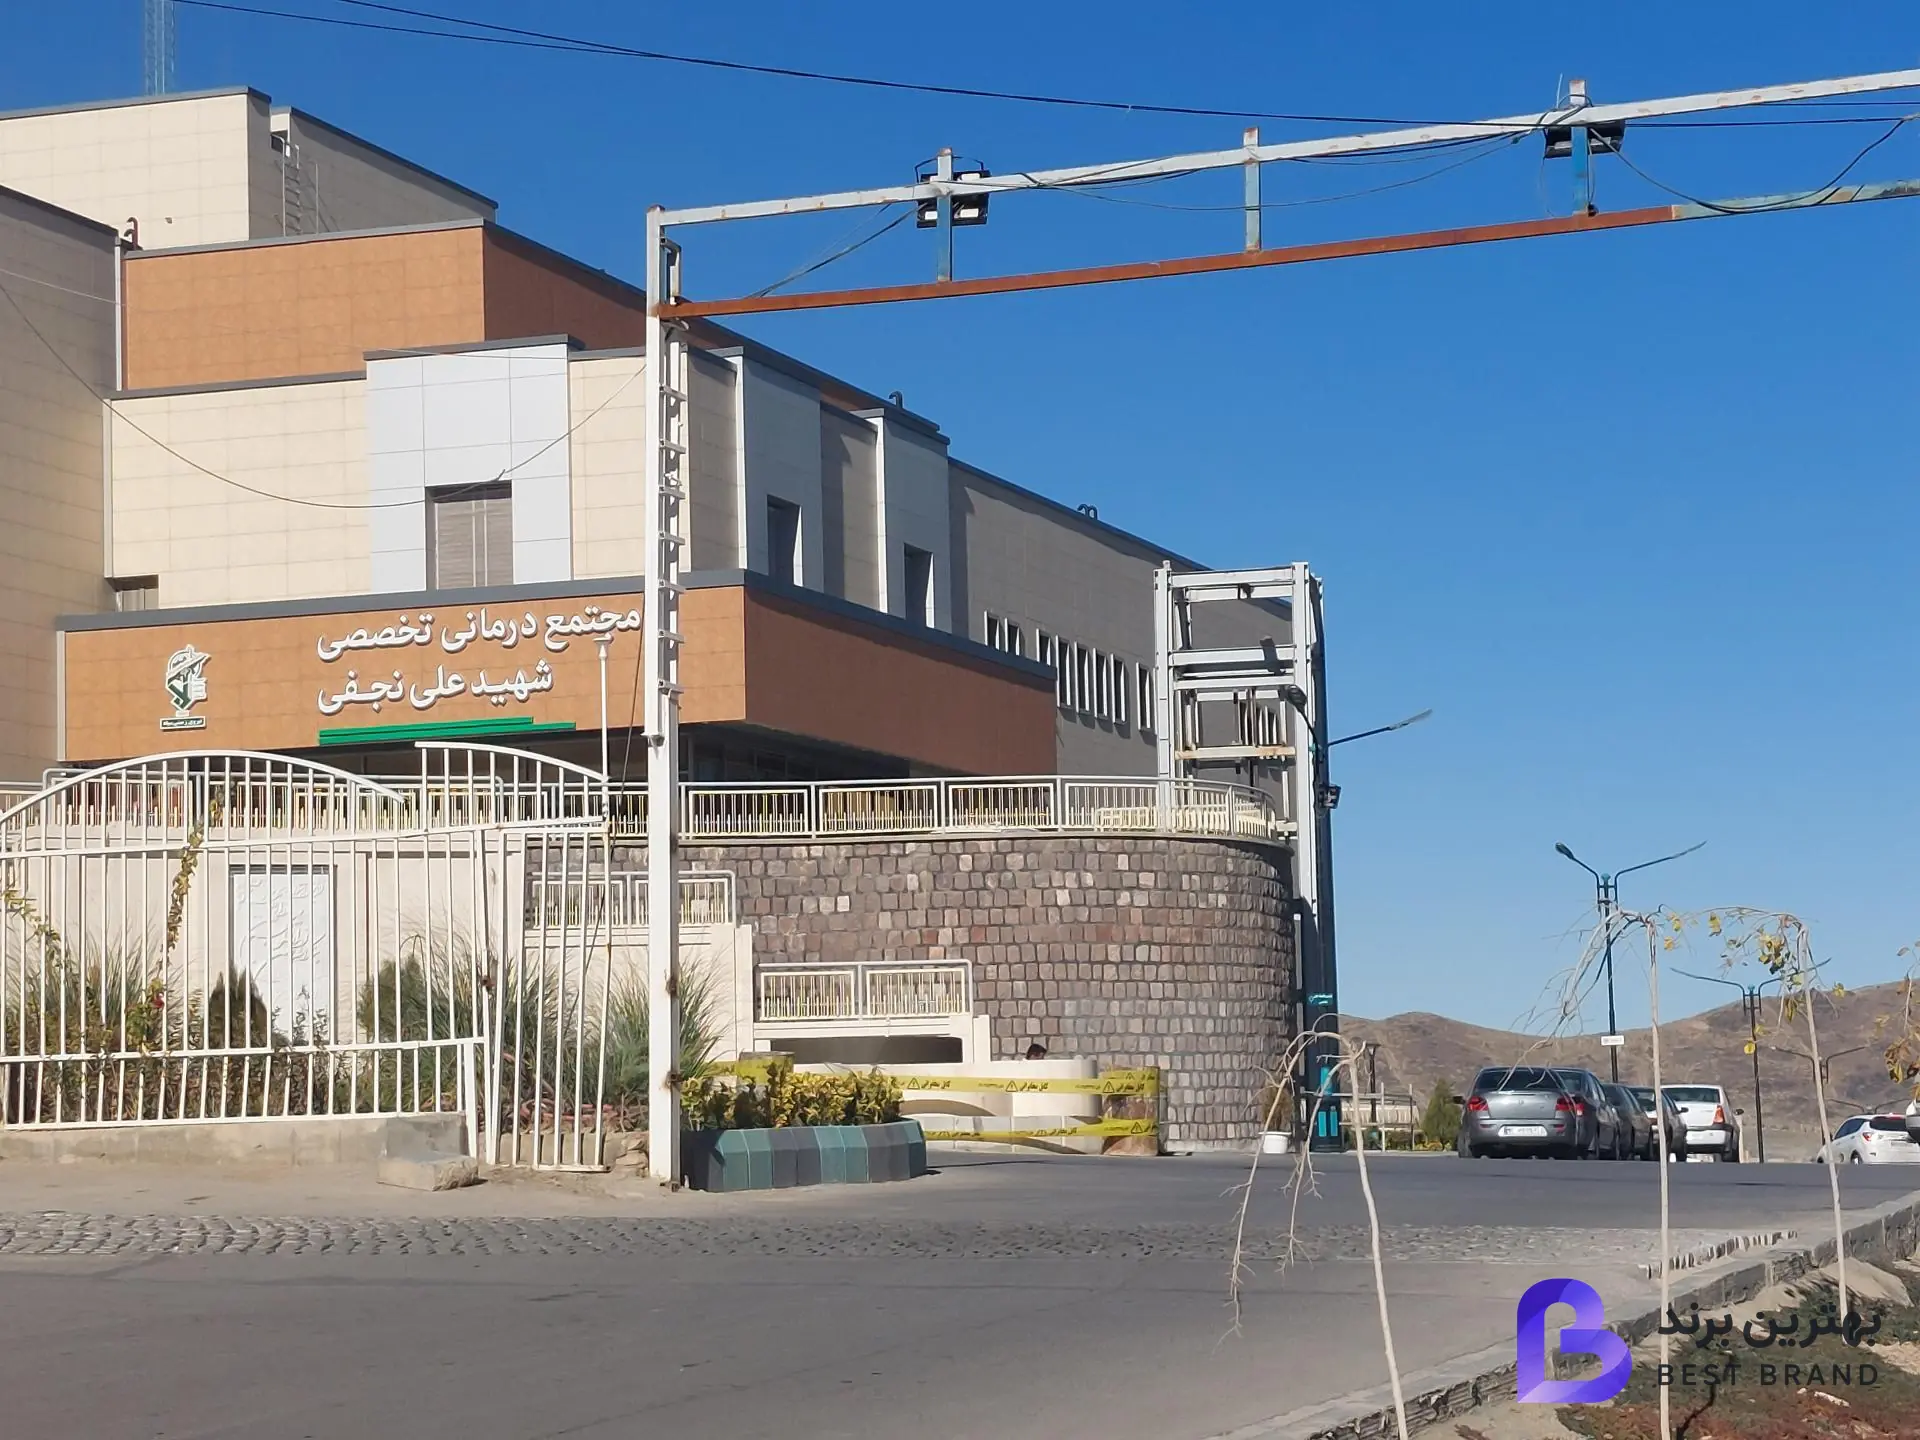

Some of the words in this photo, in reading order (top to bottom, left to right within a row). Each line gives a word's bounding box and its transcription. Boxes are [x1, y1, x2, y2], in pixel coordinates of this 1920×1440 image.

[317, 613, 435, 662] تخصصی
[440, 607, 537, 653] درمانی
[544, 604, 641, 650] مجتمع
[317, 669, 405, 715] نجفی
[409, 664, 466, 709] علی
[470, 658, 554, 707] شهید
